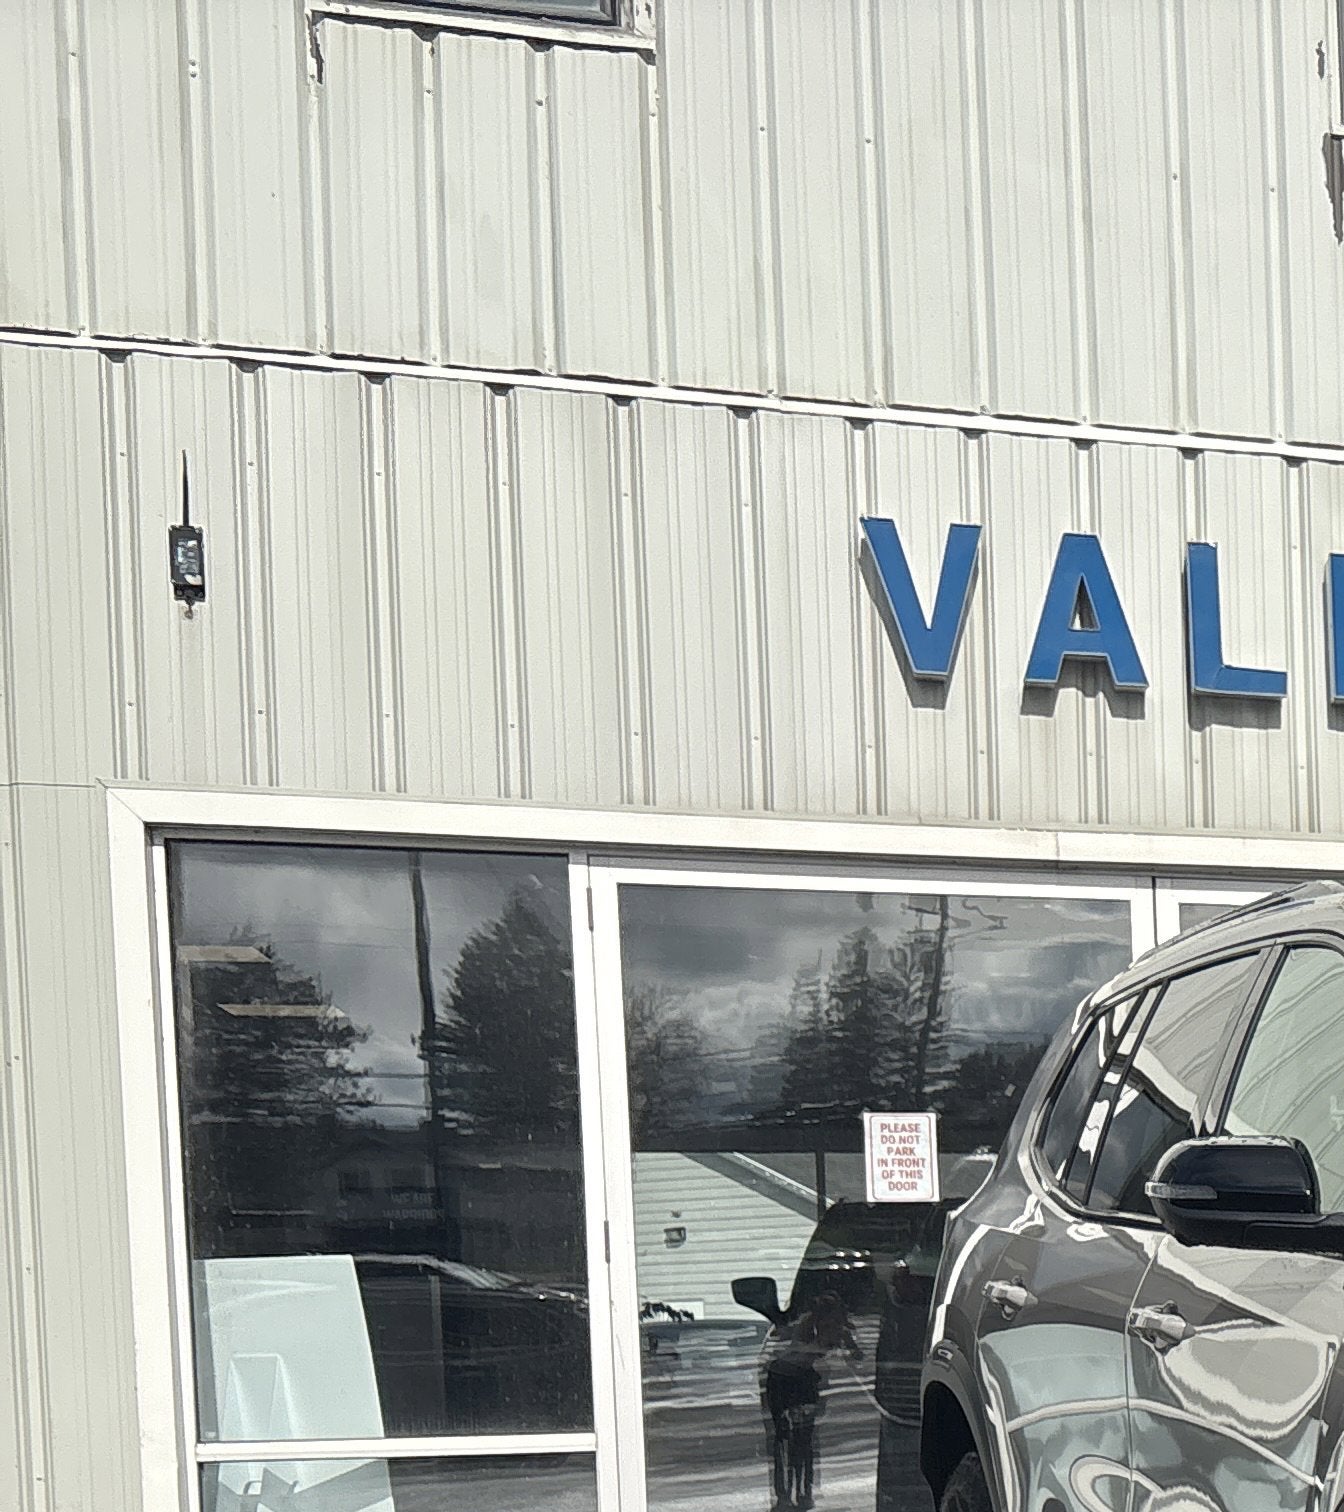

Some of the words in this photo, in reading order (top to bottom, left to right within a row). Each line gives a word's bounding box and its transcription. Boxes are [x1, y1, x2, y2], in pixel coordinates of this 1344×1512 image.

[880, 1122, 921, 1133] PLEASE
[880, 1135, 897, 1144] DO
[898, 1135, 921, 1144] NOT
[886, 1146, 916, 1156] PARK
[877, 1158, 889, 1168] IN
[892, 1158, 926, 1168] FRONT
[881, 1170, 895, 1179] OF
[898, 1170, 924, 1179] THIS
[888, 1181, 918, 1191] DOOR
